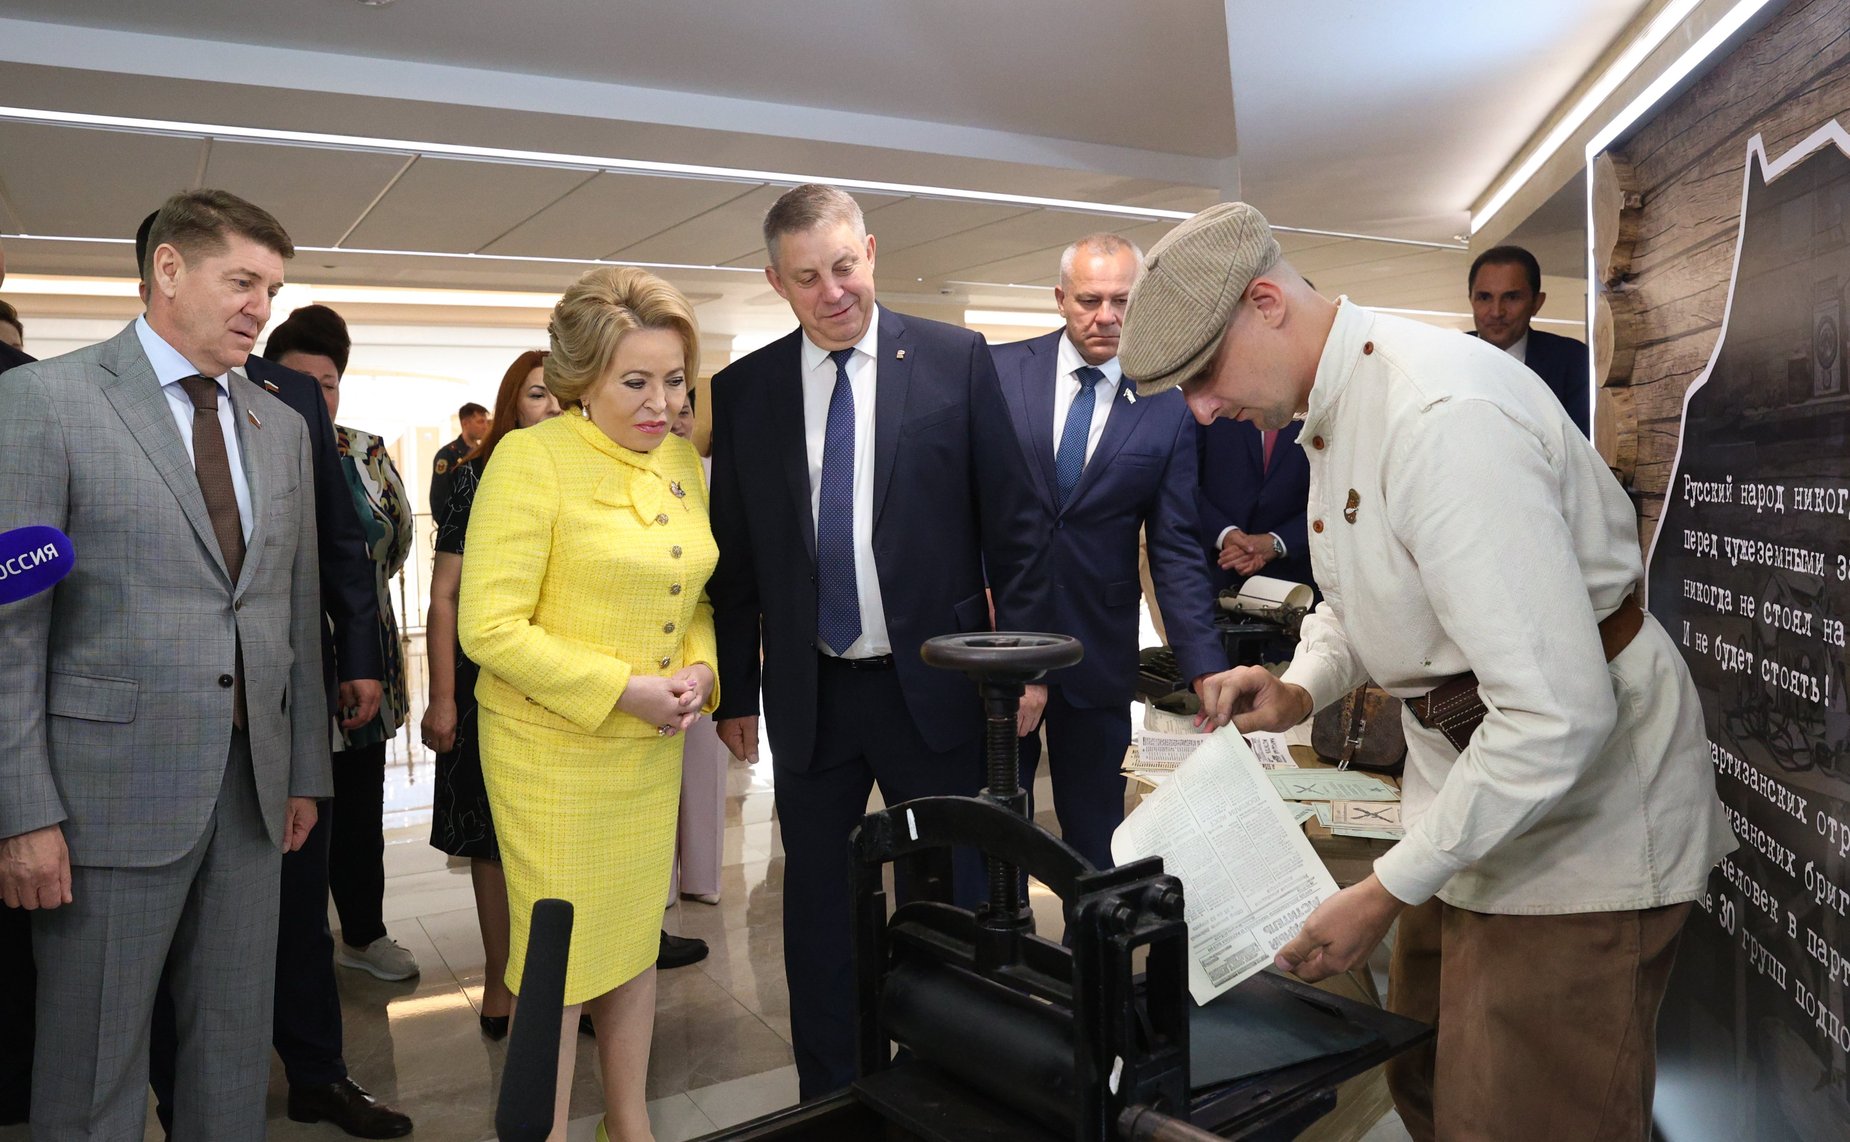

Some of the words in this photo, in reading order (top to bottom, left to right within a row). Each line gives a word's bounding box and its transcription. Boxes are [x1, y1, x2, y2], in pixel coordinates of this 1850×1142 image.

[1684, 474, 1732, 507] Русский
[1740, 483, 1785, 514] народ
[1793, 486, 1850, 520] никог
[1684, 529, 1718, 560] перед
[1724, 536, 1825, 577] чужеземными
[1837, 554, 1850, 582] з
[1684, 579, 1732, 614] никогда
[1740, 595, 1755, 618] не
[1763, 601, 1812, 637] стоял
[1823, 618, 1846, 648] на
[1683, 620, 1690, 646] И
[1695, 632, 1708, 654] не
[1714, 635, 1753, 674] будет
[1721, 801, 1796, 877] изанских
[1804, 861, 1850, 917] бриг
[1817, 811, 1850, 858] отр
[1720, 856, 1779, 923] человек
[1787, 911, 1797, 939] в
[1807, 928, 1850, 987] парт
[1719, 893, 1736, 935] 30
[1742, 928, 1787, 990] групп
[1795, 979, 1850, 1052] подпо
